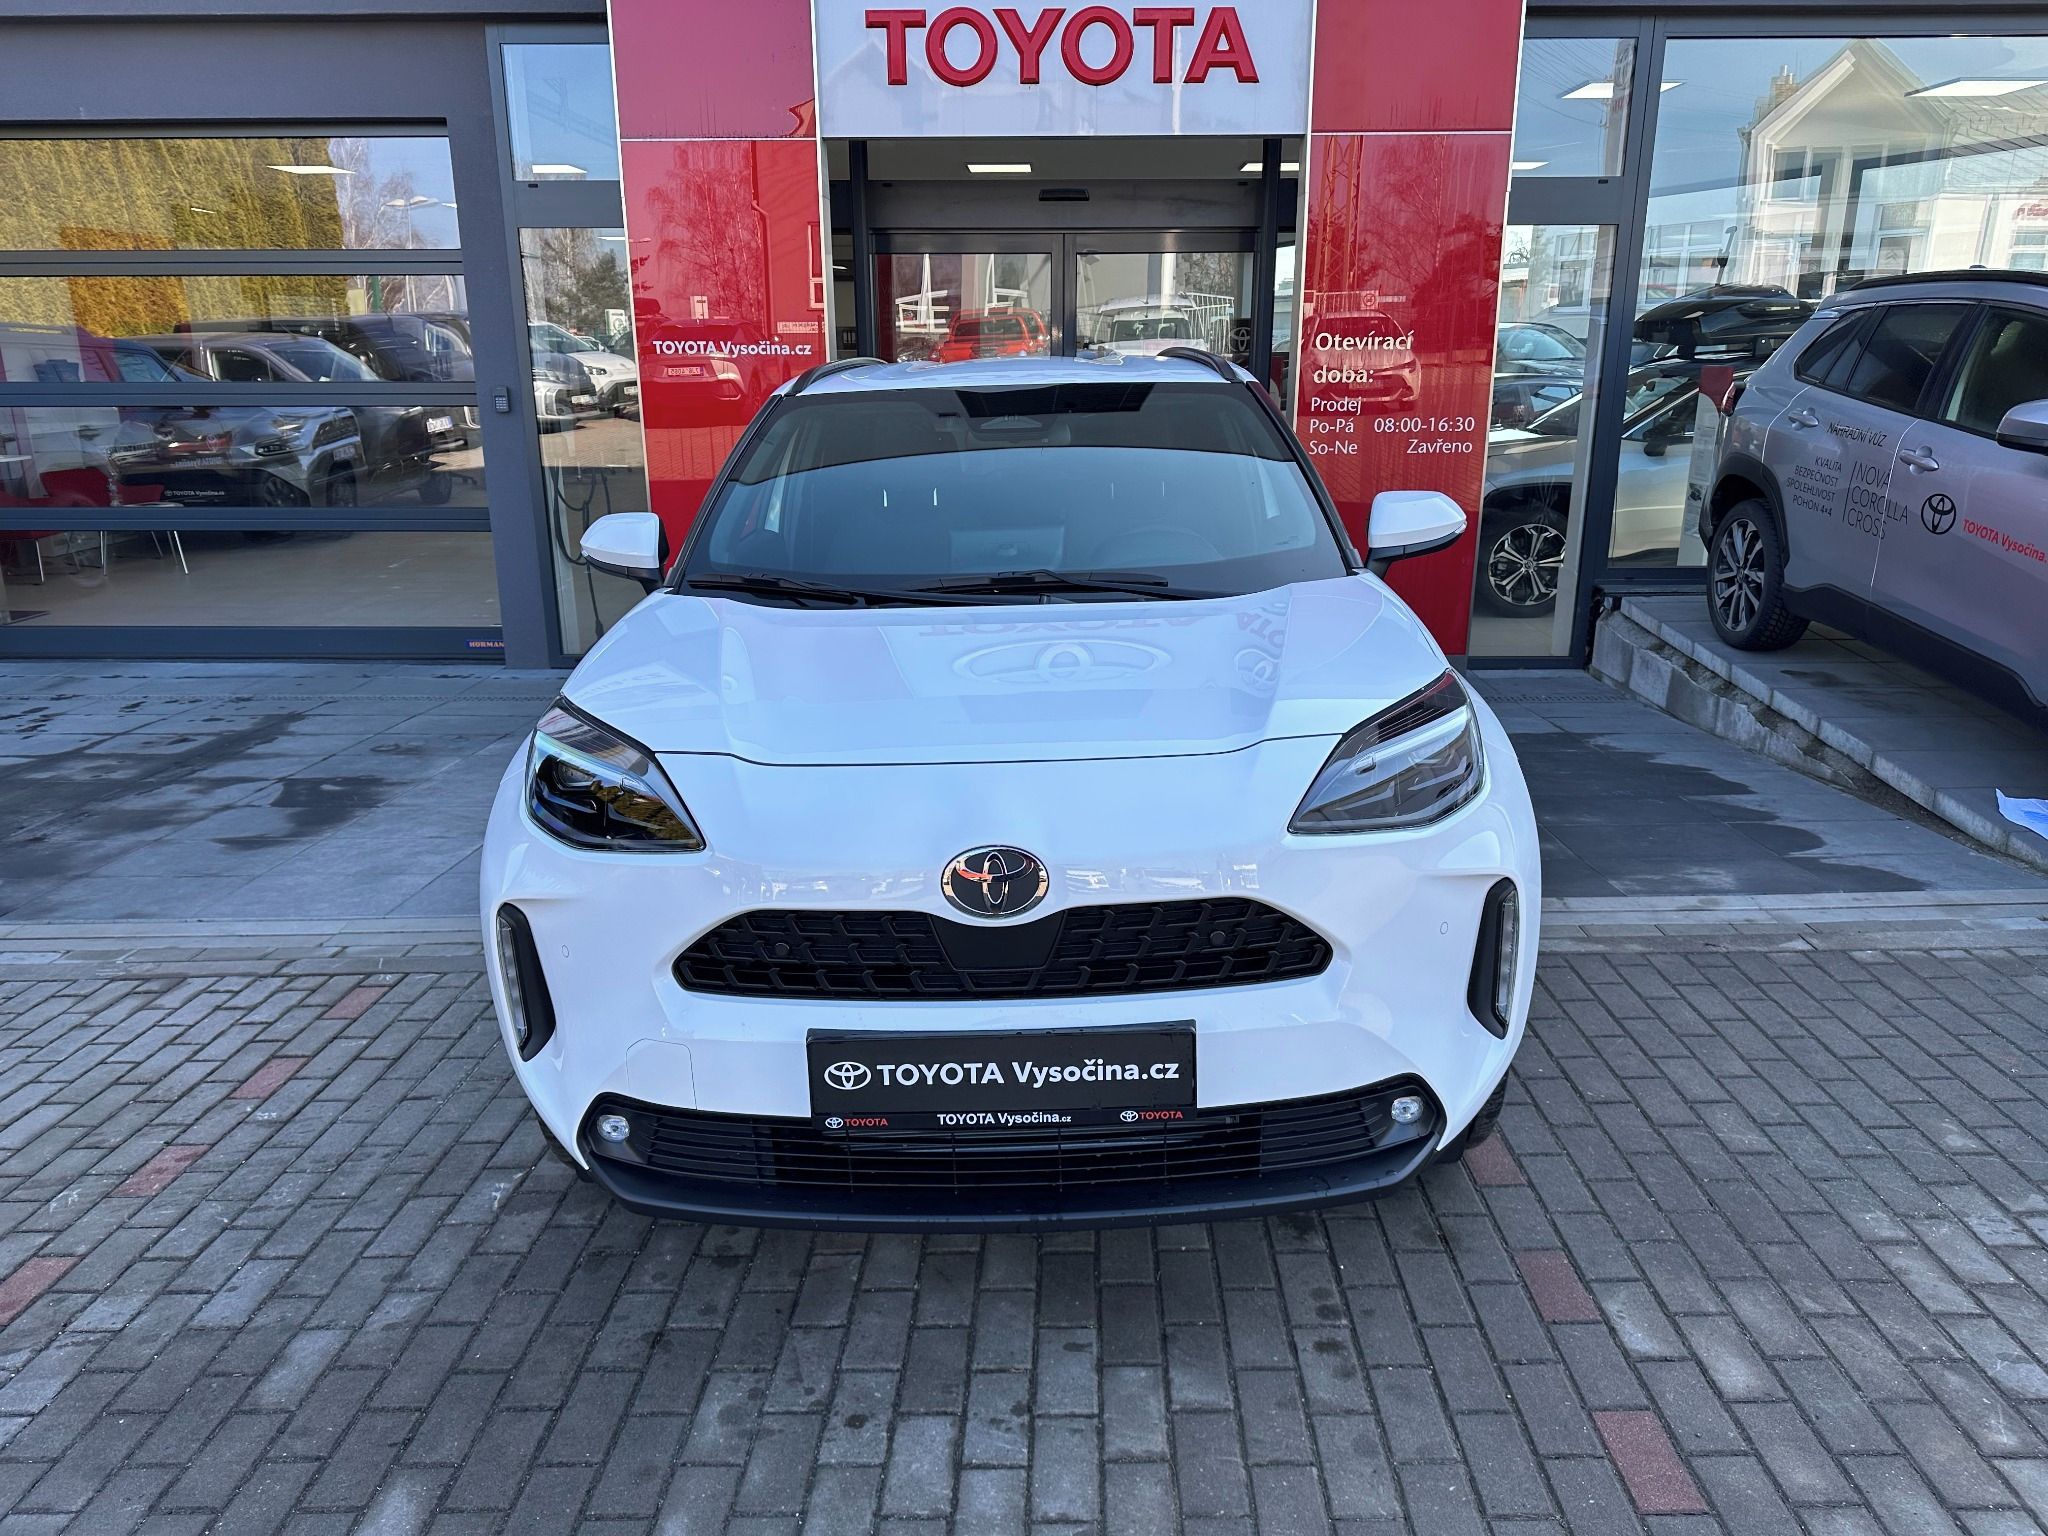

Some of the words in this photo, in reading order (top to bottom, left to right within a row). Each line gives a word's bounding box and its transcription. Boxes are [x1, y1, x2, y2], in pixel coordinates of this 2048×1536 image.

[865, 6, 1260, 87] TOYOTA
[653, 340, 717, 355] TOYOTA
[719, 339, 812, 358] Vysočina.cz
[1315, 330, 1415, 350] Otevírací
[1313, 366, 1374, 384] doba:
[1310, 396, 1361, 416] Prodej
[1309, 418, 1355, 434] Po-Pá
[1373, 416, 1475, 433] 08:00-16:30
[1308, 440, 1358, 455] So-Ne
[1406, 438, 1473, 454] Zavřeno
[1814, 456, 1842, 473] KVALITA
[1794, 465, 1839, 488] BEZPEČNOST
[1786, 477, 1836, 502] SPOLEHLIVOST
[1792, 494, 1819, 513] POHON
[1851, 485, 1908, 525] COROLLA
[1847, 508, 1888, 540] CROSS
[1963, 519, 1999, 545] TOYOTA
[876, 1062, 1005, 1087] TOYOTA
[1011, 1058, 1180, 1089] Vysočina.cz
[844, 1118, 889, 1127] TOYOTA
[936, 1112, 996, 1126] TOYOTA
[998, 1111, 1072, 1127] Vysočina.cz
[1139, 1110, 1184, 1121] TOYOTA
